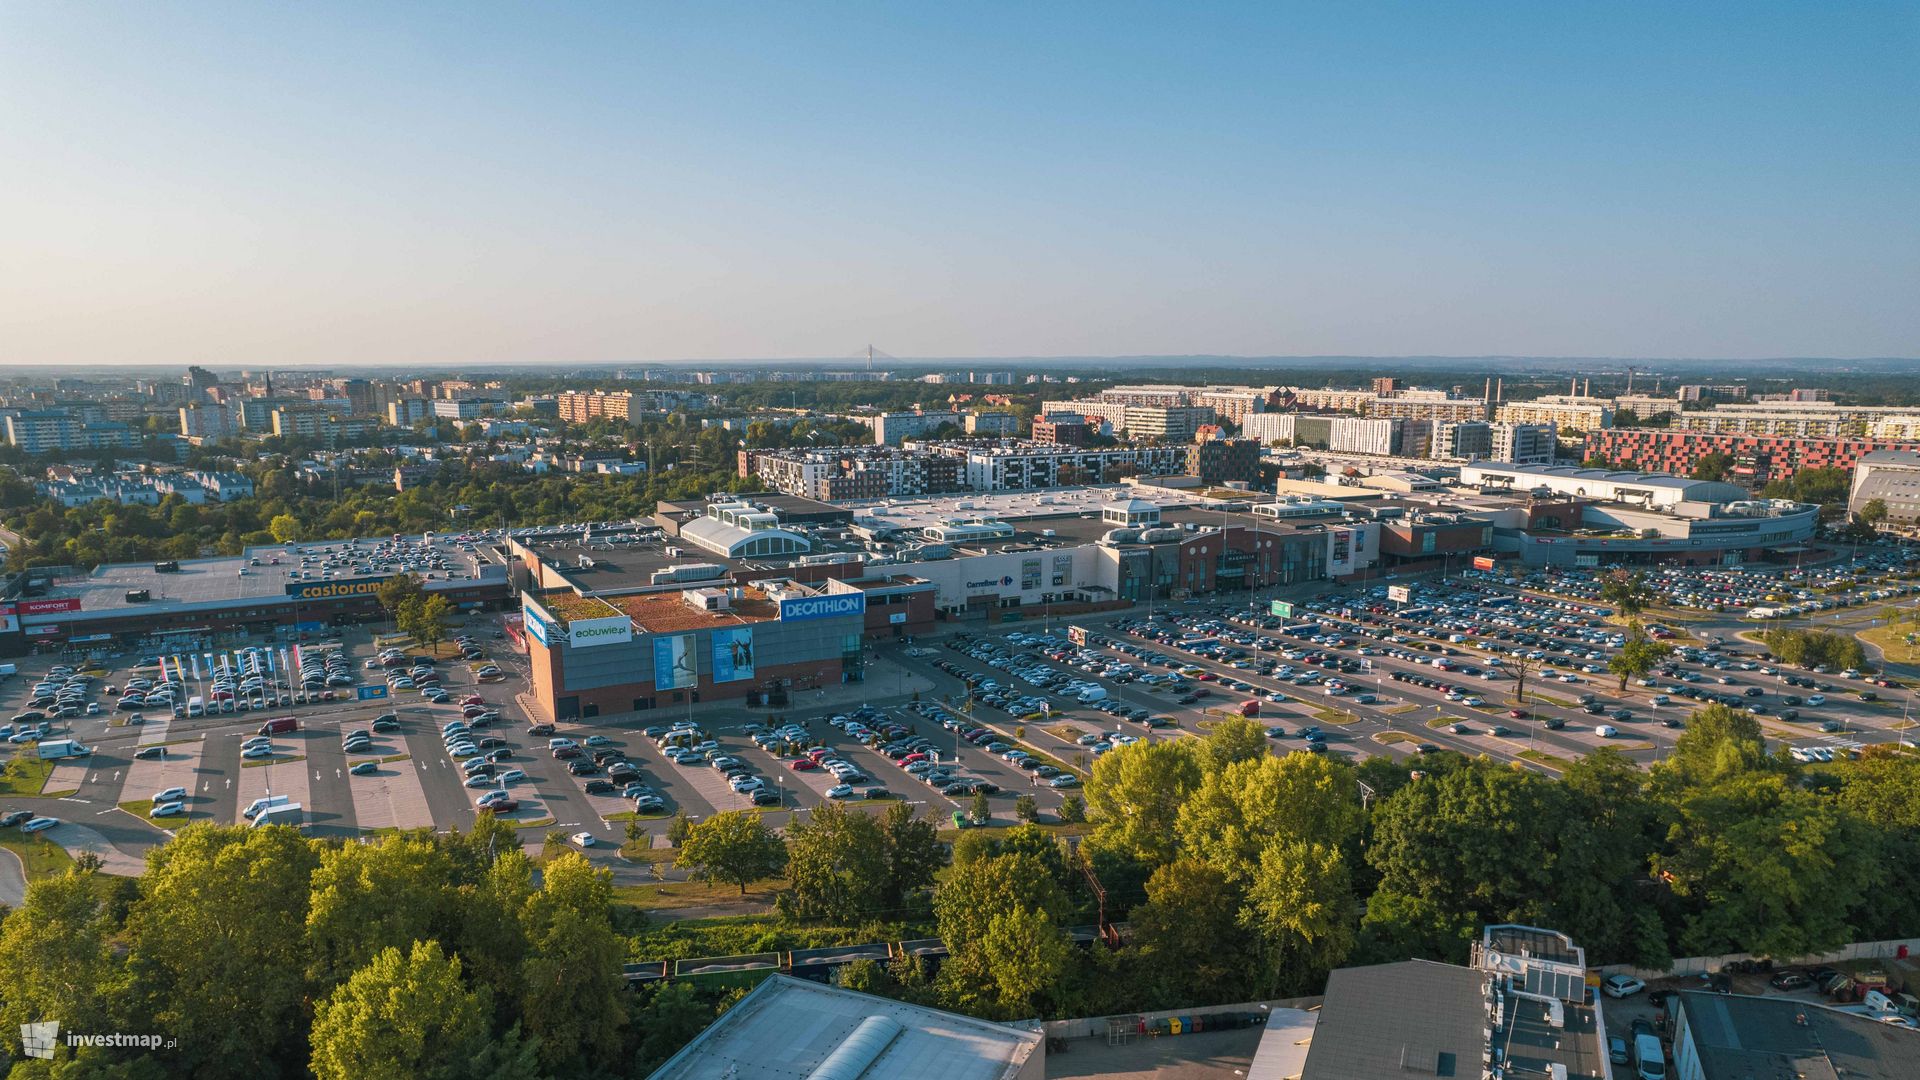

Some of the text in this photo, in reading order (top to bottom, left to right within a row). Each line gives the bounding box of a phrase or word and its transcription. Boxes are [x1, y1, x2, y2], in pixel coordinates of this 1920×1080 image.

[966, 580, 998, 588] Carrefour
[29, 602, 69, 610] KOMFORT
[785, 597, 859, 617] DECATHLON
[575, 626, 626, 638] eobuwie.pl
